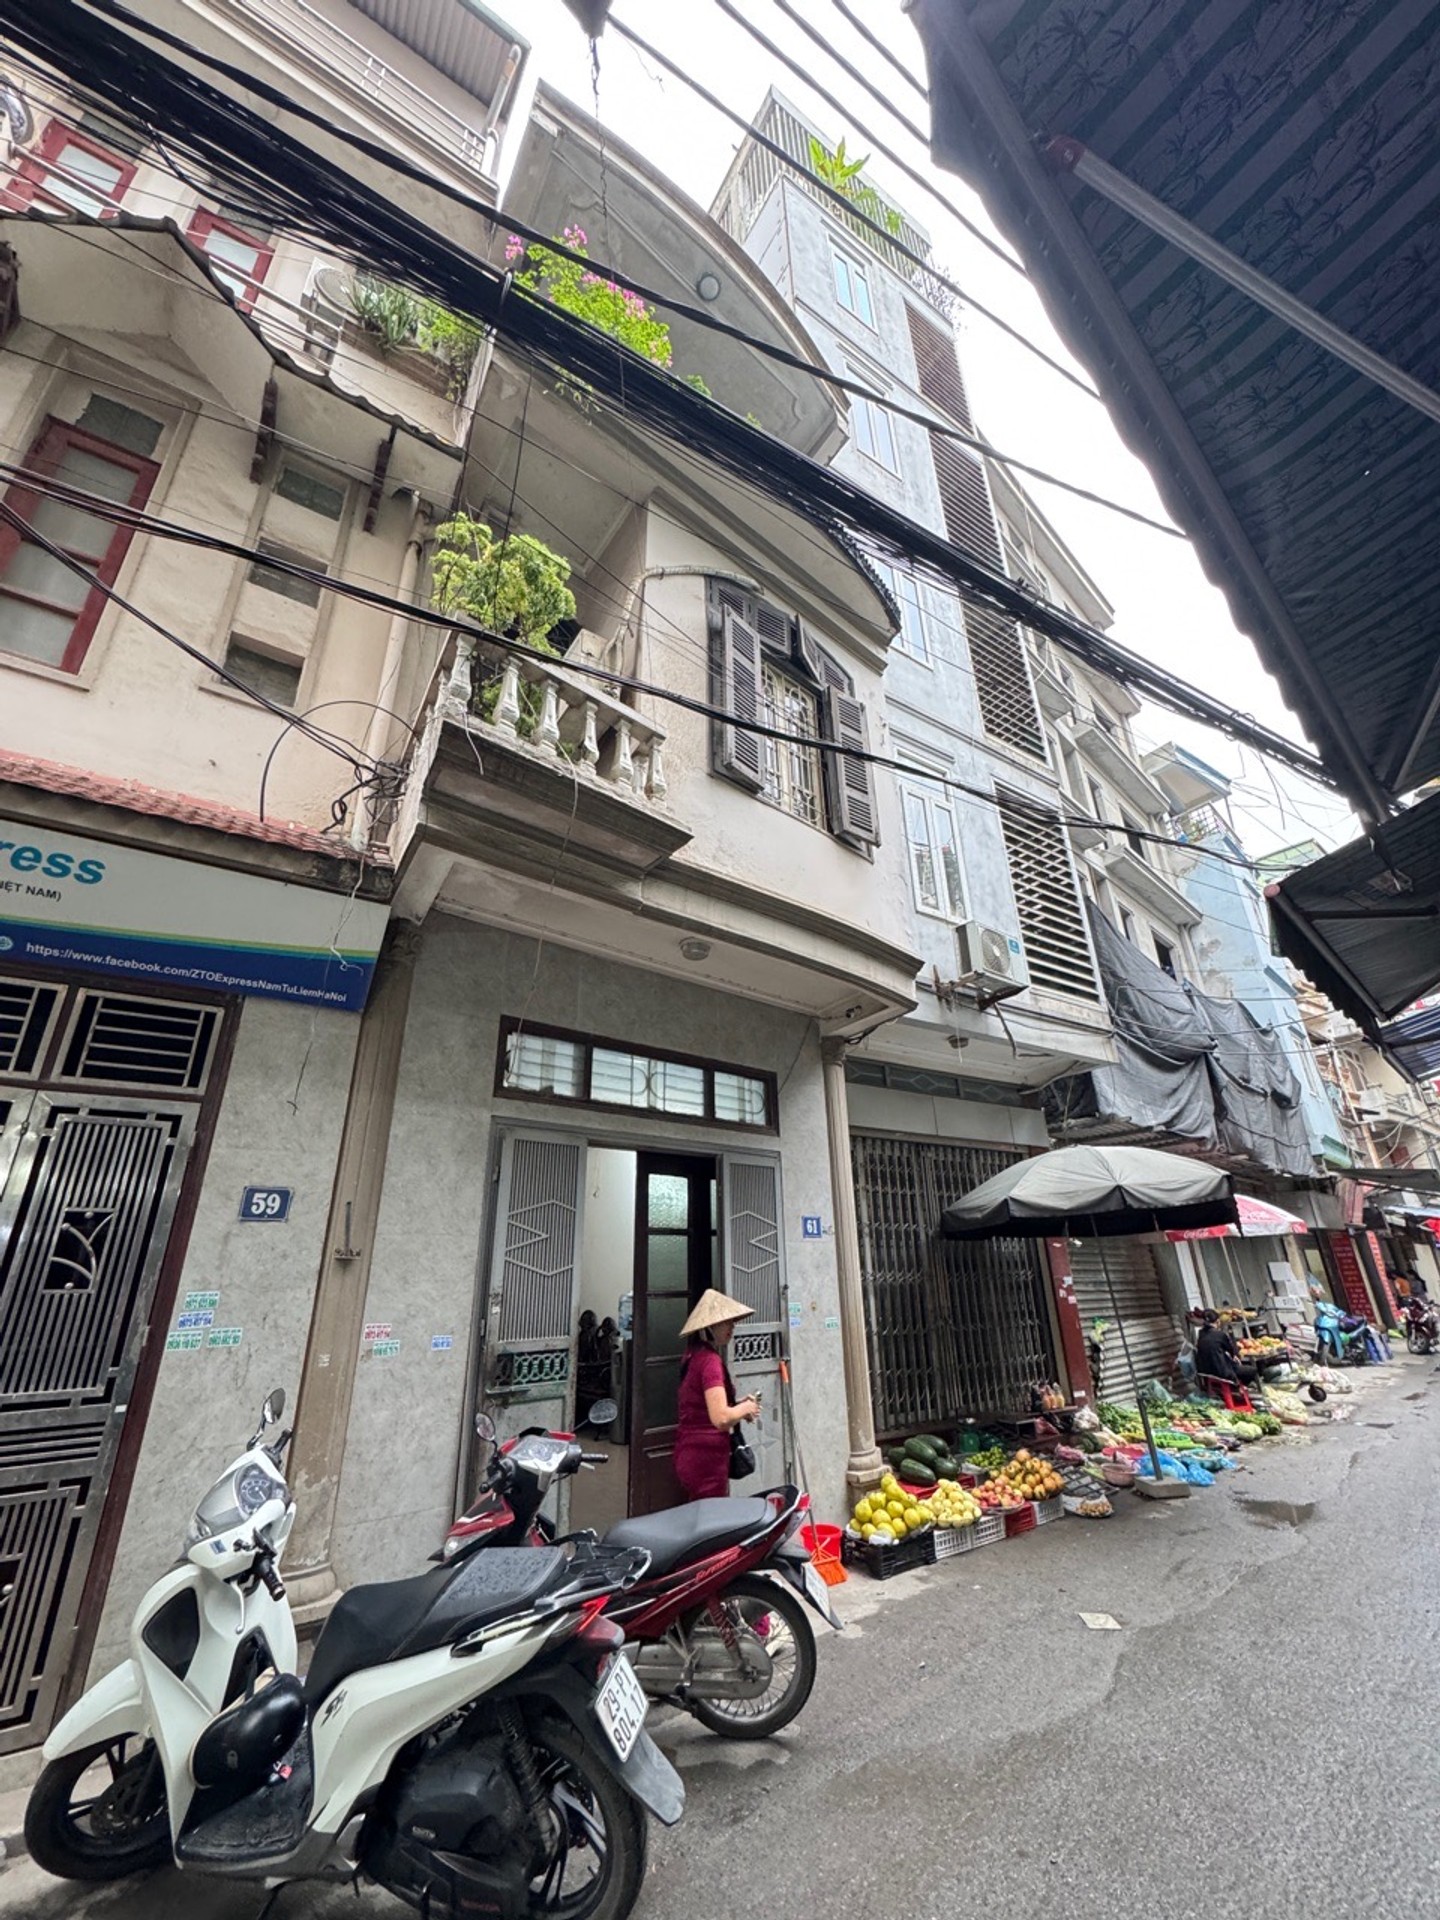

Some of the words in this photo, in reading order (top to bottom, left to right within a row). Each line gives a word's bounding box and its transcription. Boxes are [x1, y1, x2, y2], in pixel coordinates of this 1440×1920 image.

[25, 885, 62, 902] NAM)
[250, 1193, 282, 1215] 59
[806, 1219, 818, 1234] 61
